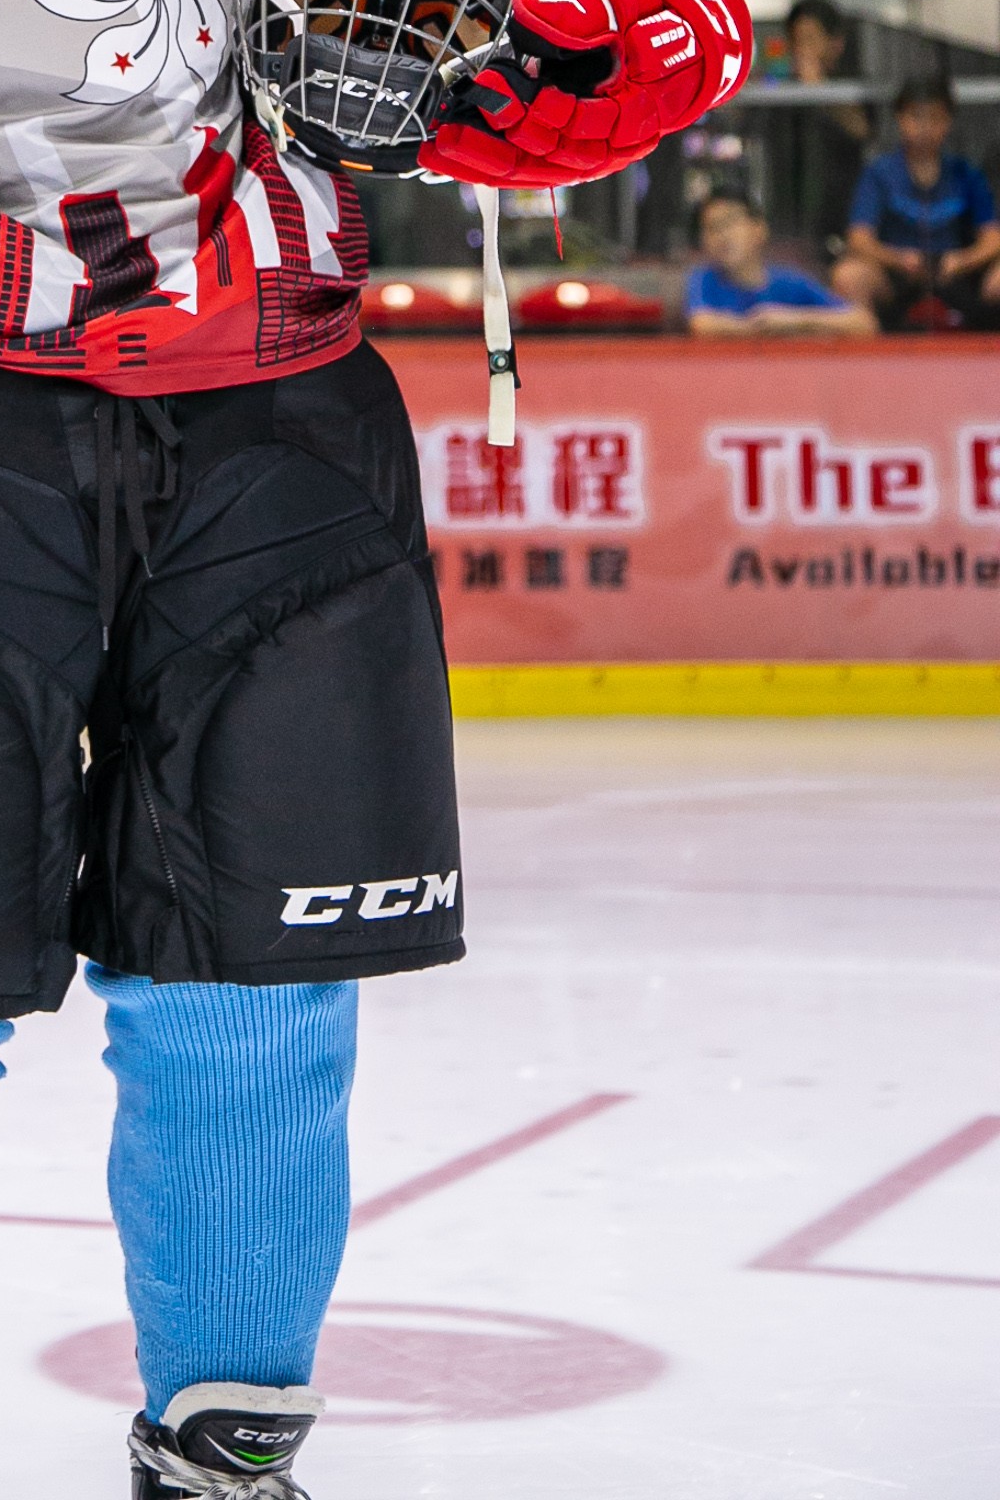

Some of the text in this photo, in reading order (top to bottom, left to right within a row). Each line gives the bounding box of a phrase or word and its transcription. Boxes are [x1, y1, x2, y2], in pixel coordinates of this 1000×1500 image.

[717, 434, 924, 514] The
[279, 869, 459, 928] CCM
[232, 1426, 300, 1444] CCM
